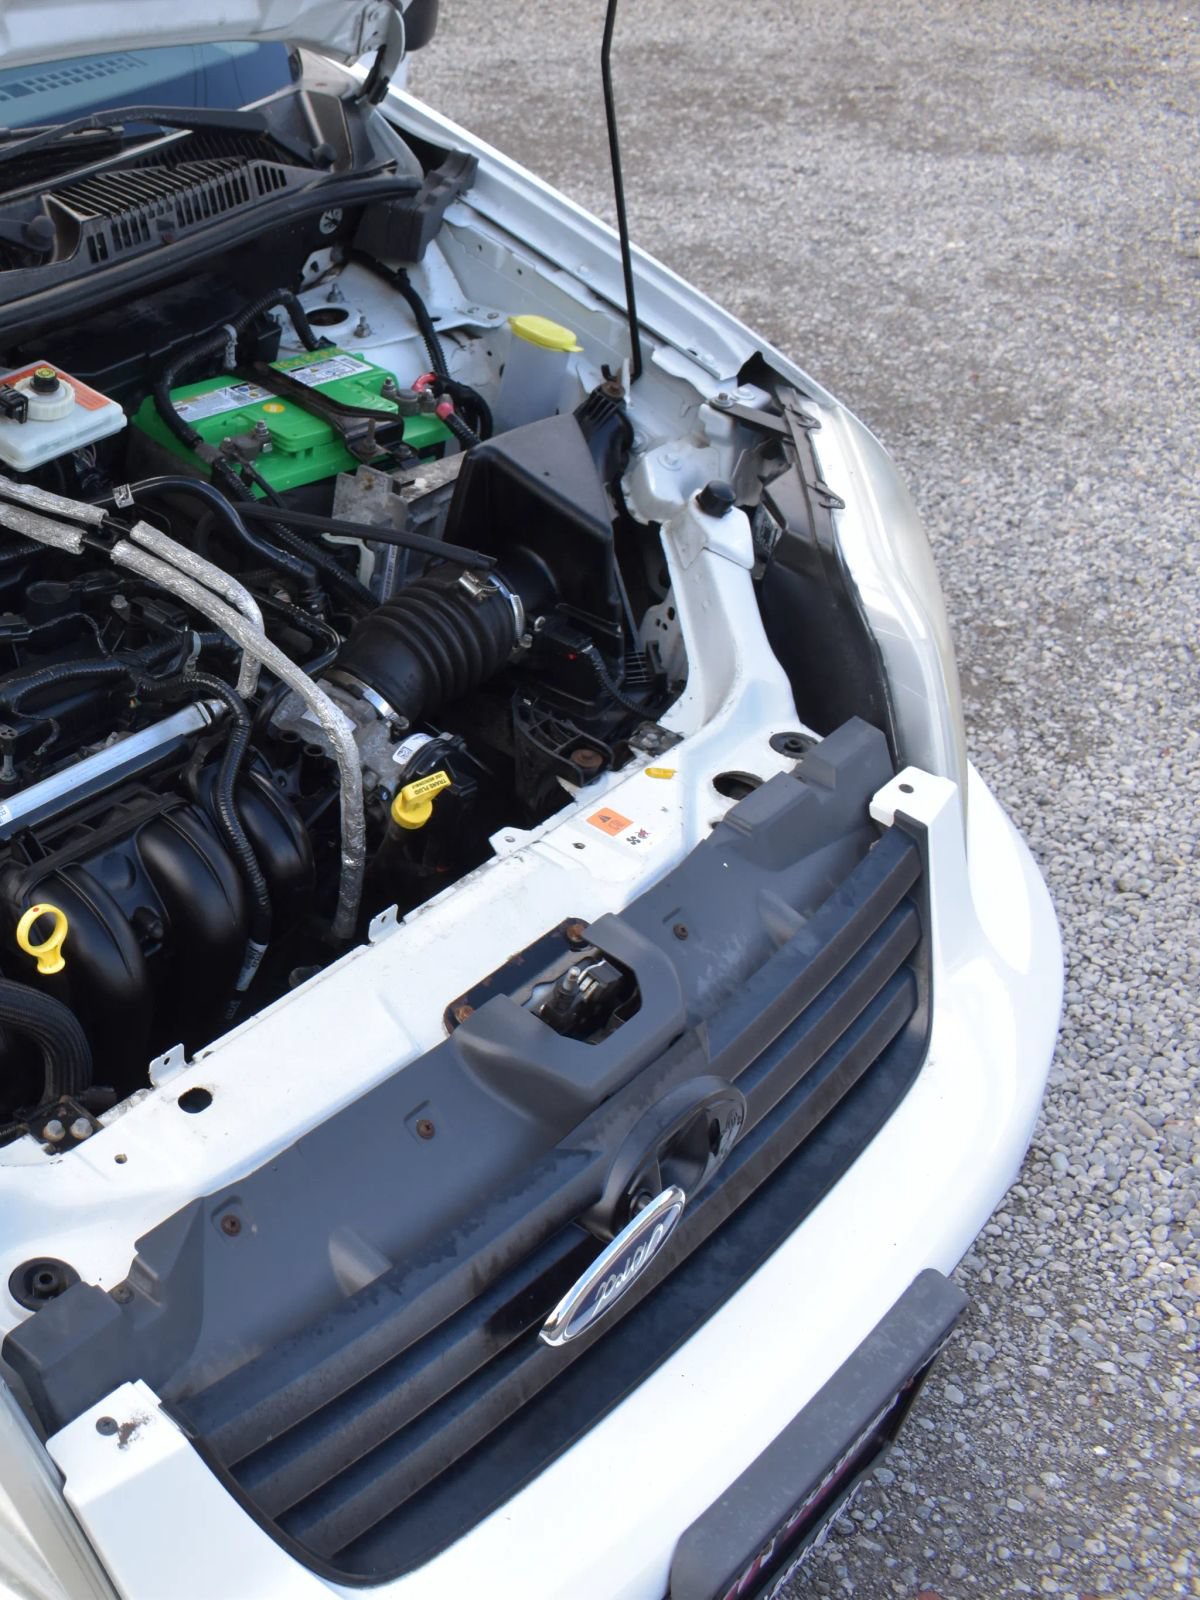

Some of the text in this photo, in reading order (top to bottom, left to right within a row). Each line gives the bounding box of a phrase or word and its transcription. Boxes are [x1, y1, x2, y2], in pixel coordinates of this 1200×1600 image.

[429, 778, 447, 789] TRANS
[414, 785, 430, 795] FLUID
[591, 1223, 664, 1317] Ford
